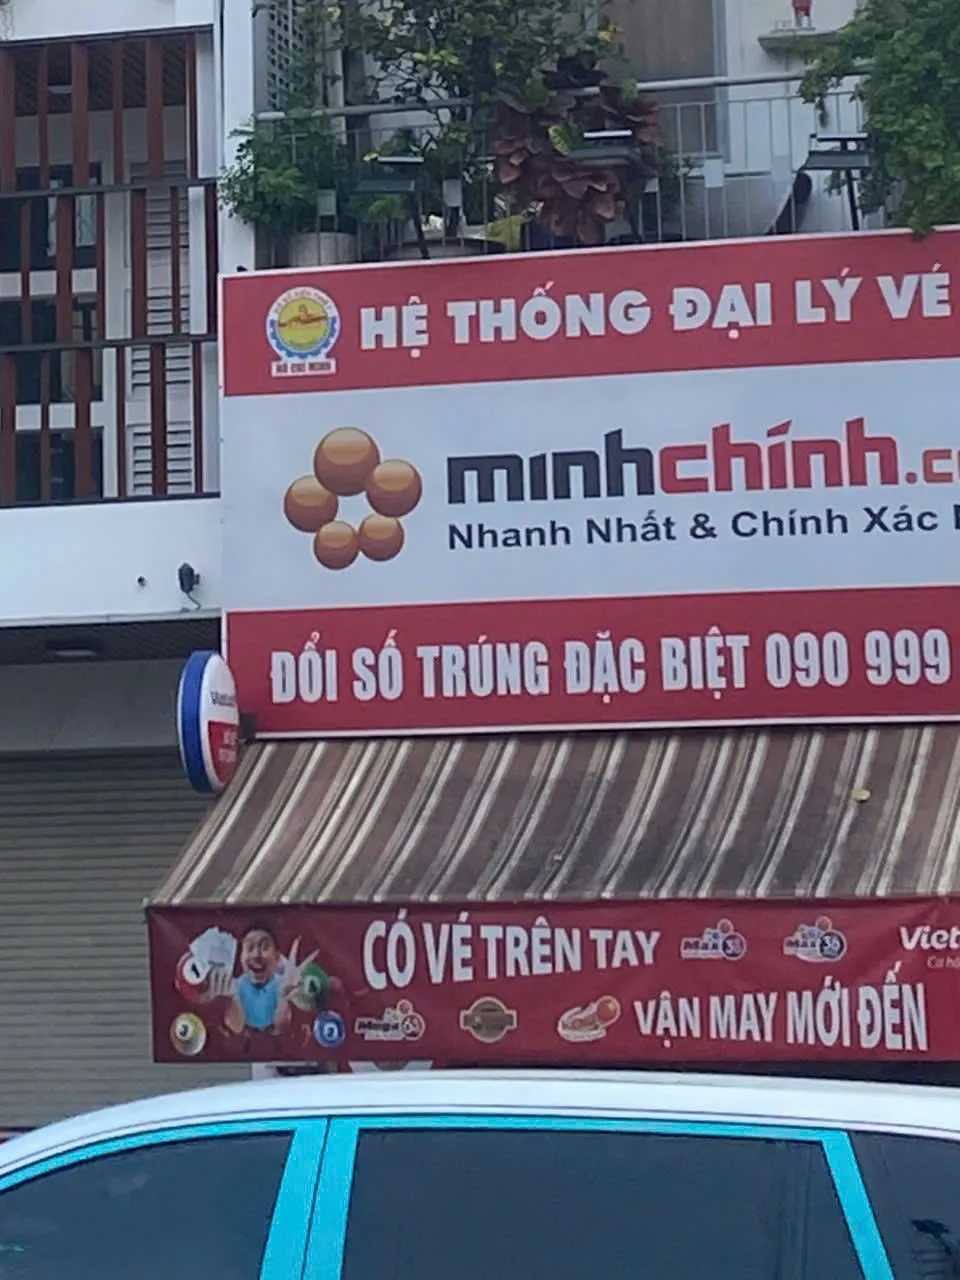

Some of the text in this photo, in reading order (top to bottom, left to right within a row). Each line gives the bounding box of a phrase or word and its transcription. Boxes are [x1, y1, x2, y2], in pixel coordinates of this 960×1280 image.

[360, 296, 429, 358] HỆ
[447, 281, 651, 344] THỐNG
[669, 282, 772, 339] ĐẠI
[795, 267, 863, 323] LÝ
[876, 263, 951, 319] VÉ
[447, 417, 960, 504] minhchính.c
[449, 520, 571, 550] Nhanh
[586, 509, 677, 544] Nhất
[690, 513, 717, 539] &
[731, 508, 848, 537] Chính
[863, 505, 938, 533] Xác
[270, 625, 951, 703] ĐỔI SỐ TRÚNG ĐẶC BIỆT 090 999
[364, 908, 661, 990] CÓ VÉ TRÊN TAY
[633, 960, 928, 1051] VẬN MAY MỚI ĐẾN
